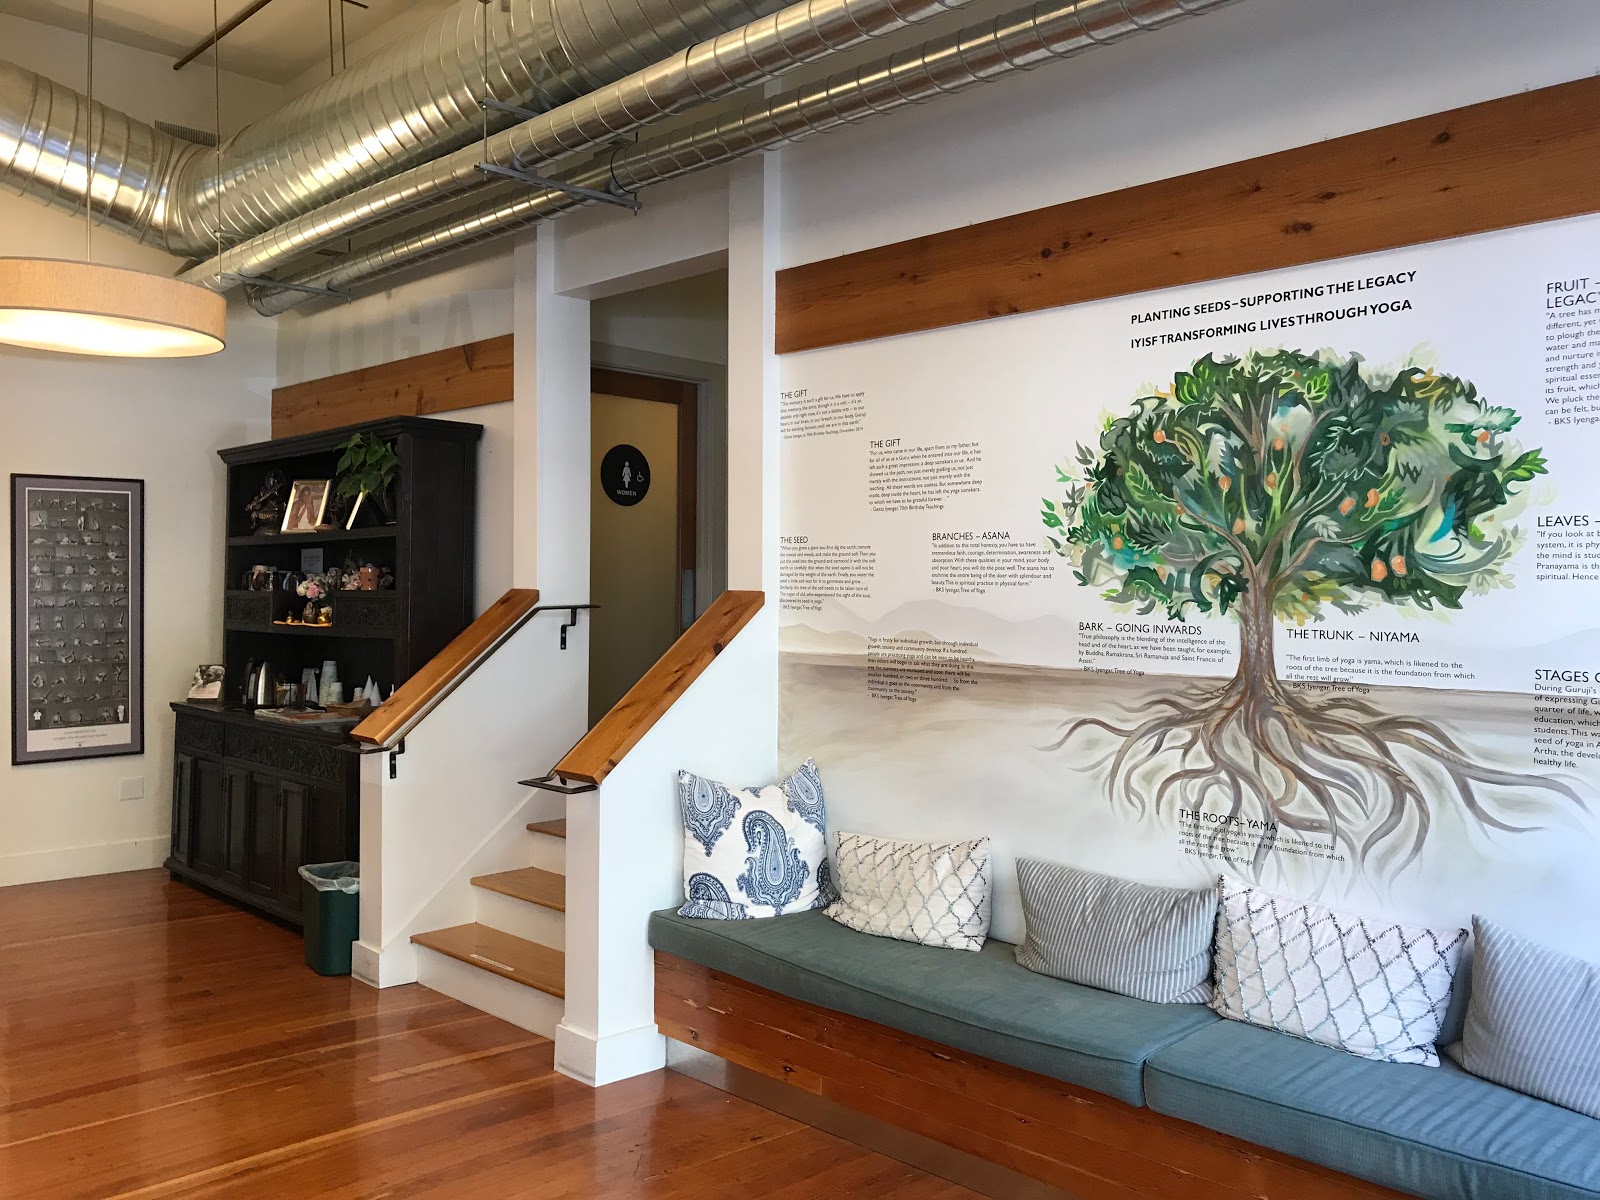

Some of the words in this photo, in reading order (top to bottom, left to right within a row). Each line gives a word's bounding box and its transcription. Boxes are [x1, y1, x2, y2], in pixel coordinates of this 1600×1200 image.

[1546, 278, 1590, 294] FRUIT
[1132, 307, 1190, 324] PLANTING
[1327, 281, 1354, 294] THE
[1358, 271, 1416, 290] LEGACY
[1546, 291, 1600, 308] LEGAC
[1132, 336, 1157, 348] IYISF
[1160, 322, 1256, 344] TRANSFORMING
[1261, 317, 1295, 330] LIVES
[1296, 306, 1367, 325] THROUGH
[1370, 300, 1412, 314] YOGA
[1583, 318, 1596, 327] yet
[1557, 330, 1585, 341] plough
[1571, 340, 1587, 348] and
[1546, 362, 1579, 372] strength
[1546, 373, 1578, 384] spiritual
[794, 389, 807, 398] GIFT
[1561, 394, 1584, 404] pluck
[1573, 416, 1600, 424] Iyenga
[871, 440, 883, 448] THE
[886, 439, 900, 447] GIFT
[1538, 515, 1588, 527] LEAVES
[933, 532, 973, 540] BRANCHES
[1537, 562, 1579, 571] Pranayama
[1079, 622, 1103, 631] BARK
[1116, 623, 1149, 633] GOING
[1153, 625, 1201, 635] INWARDS
[1287, 629, 1308, 638] THE
[1311, 630, 1353, 640] TRUNK
[1370, 632, 1419, 642] NIYAMA
[1394, 668, 1432, 677] foundation
[1535, 669, 1588, 682] STAGES
[1355, 685, 1370, 694] Yoga
[1535, 684, 1563, 694] During
[1564, 685, 1597, 694] Guruji's
[1545, 696, 1588, 705] expressing
[1534, 757, 1562, 768] healthy
[1179, 809, 1200, 820] THE
